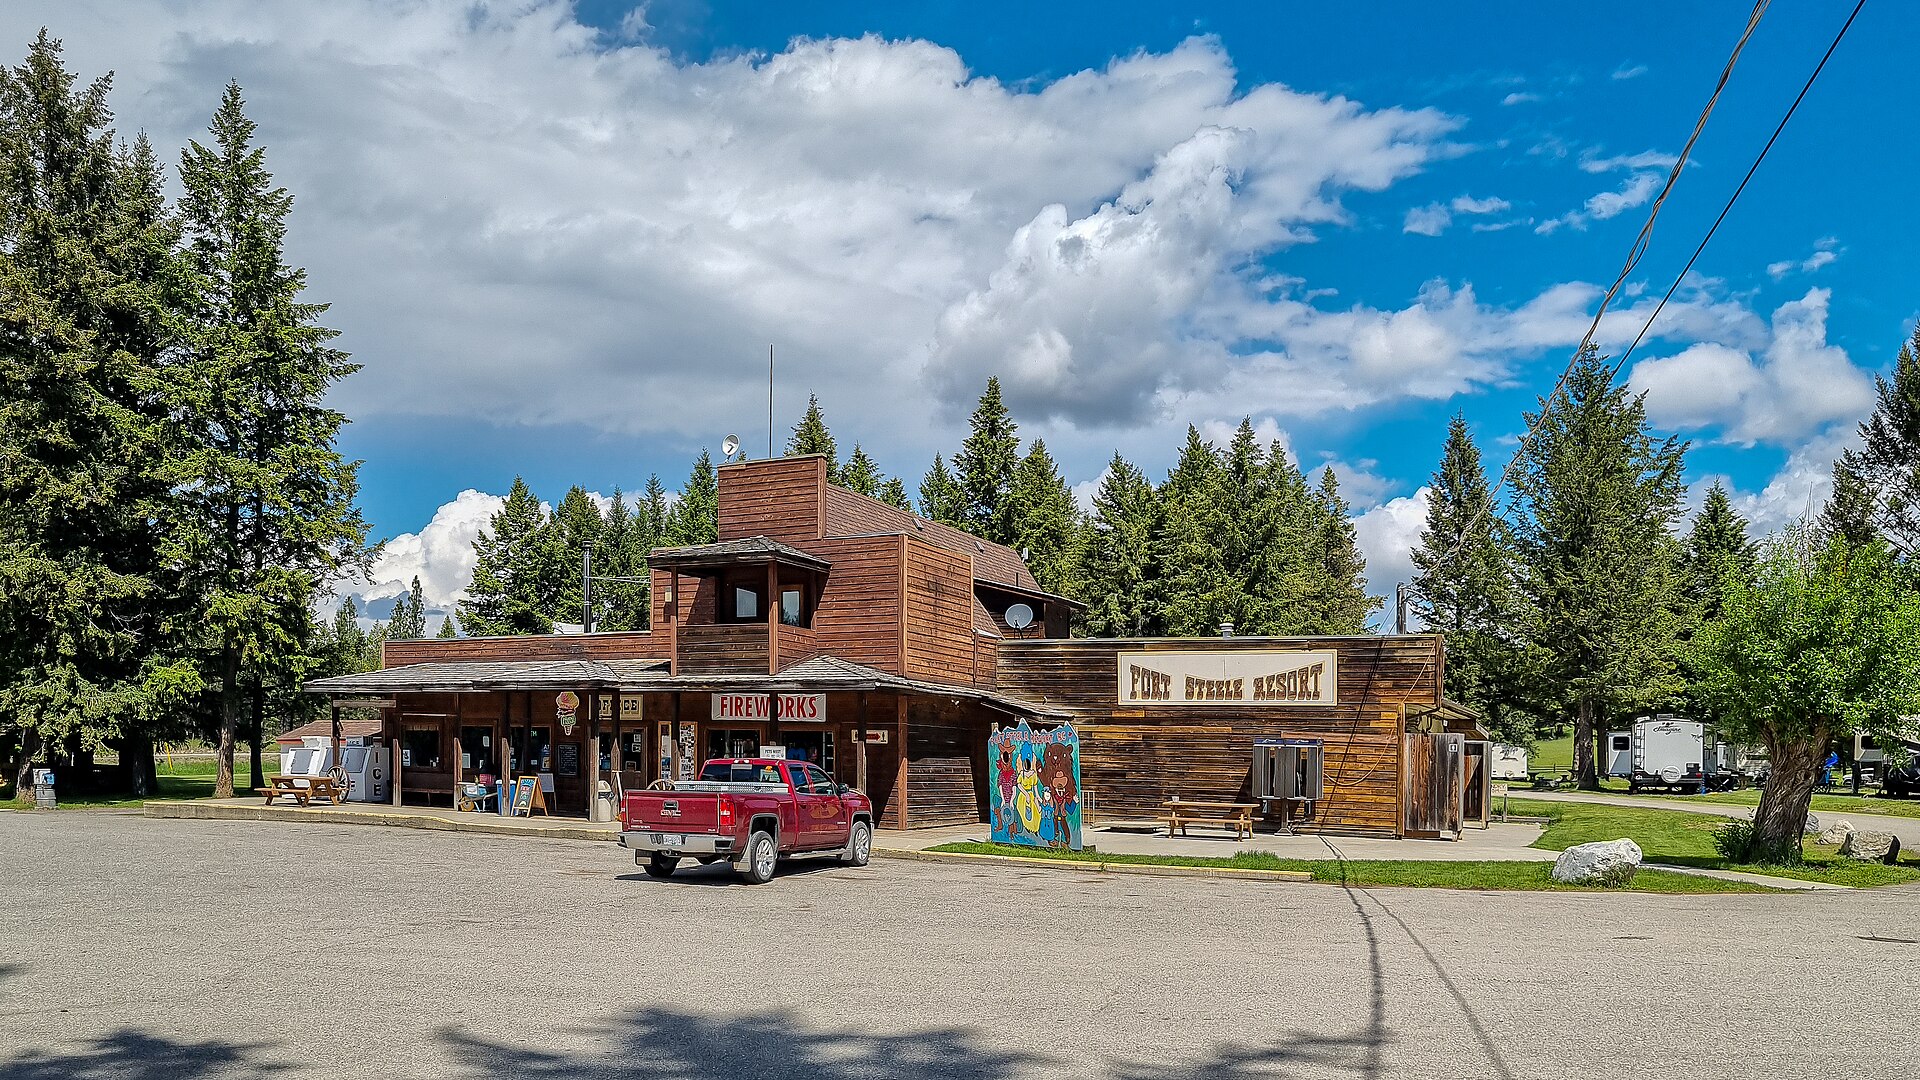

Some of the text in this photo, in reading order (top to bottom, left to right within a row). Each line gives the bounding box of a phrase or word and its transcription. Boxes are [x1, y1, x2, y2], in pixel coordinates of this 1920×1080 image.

[1130, 661, 1325, 700] FORT STEELE RESORT
[720, 696, 817, 718] FIREWORKS
